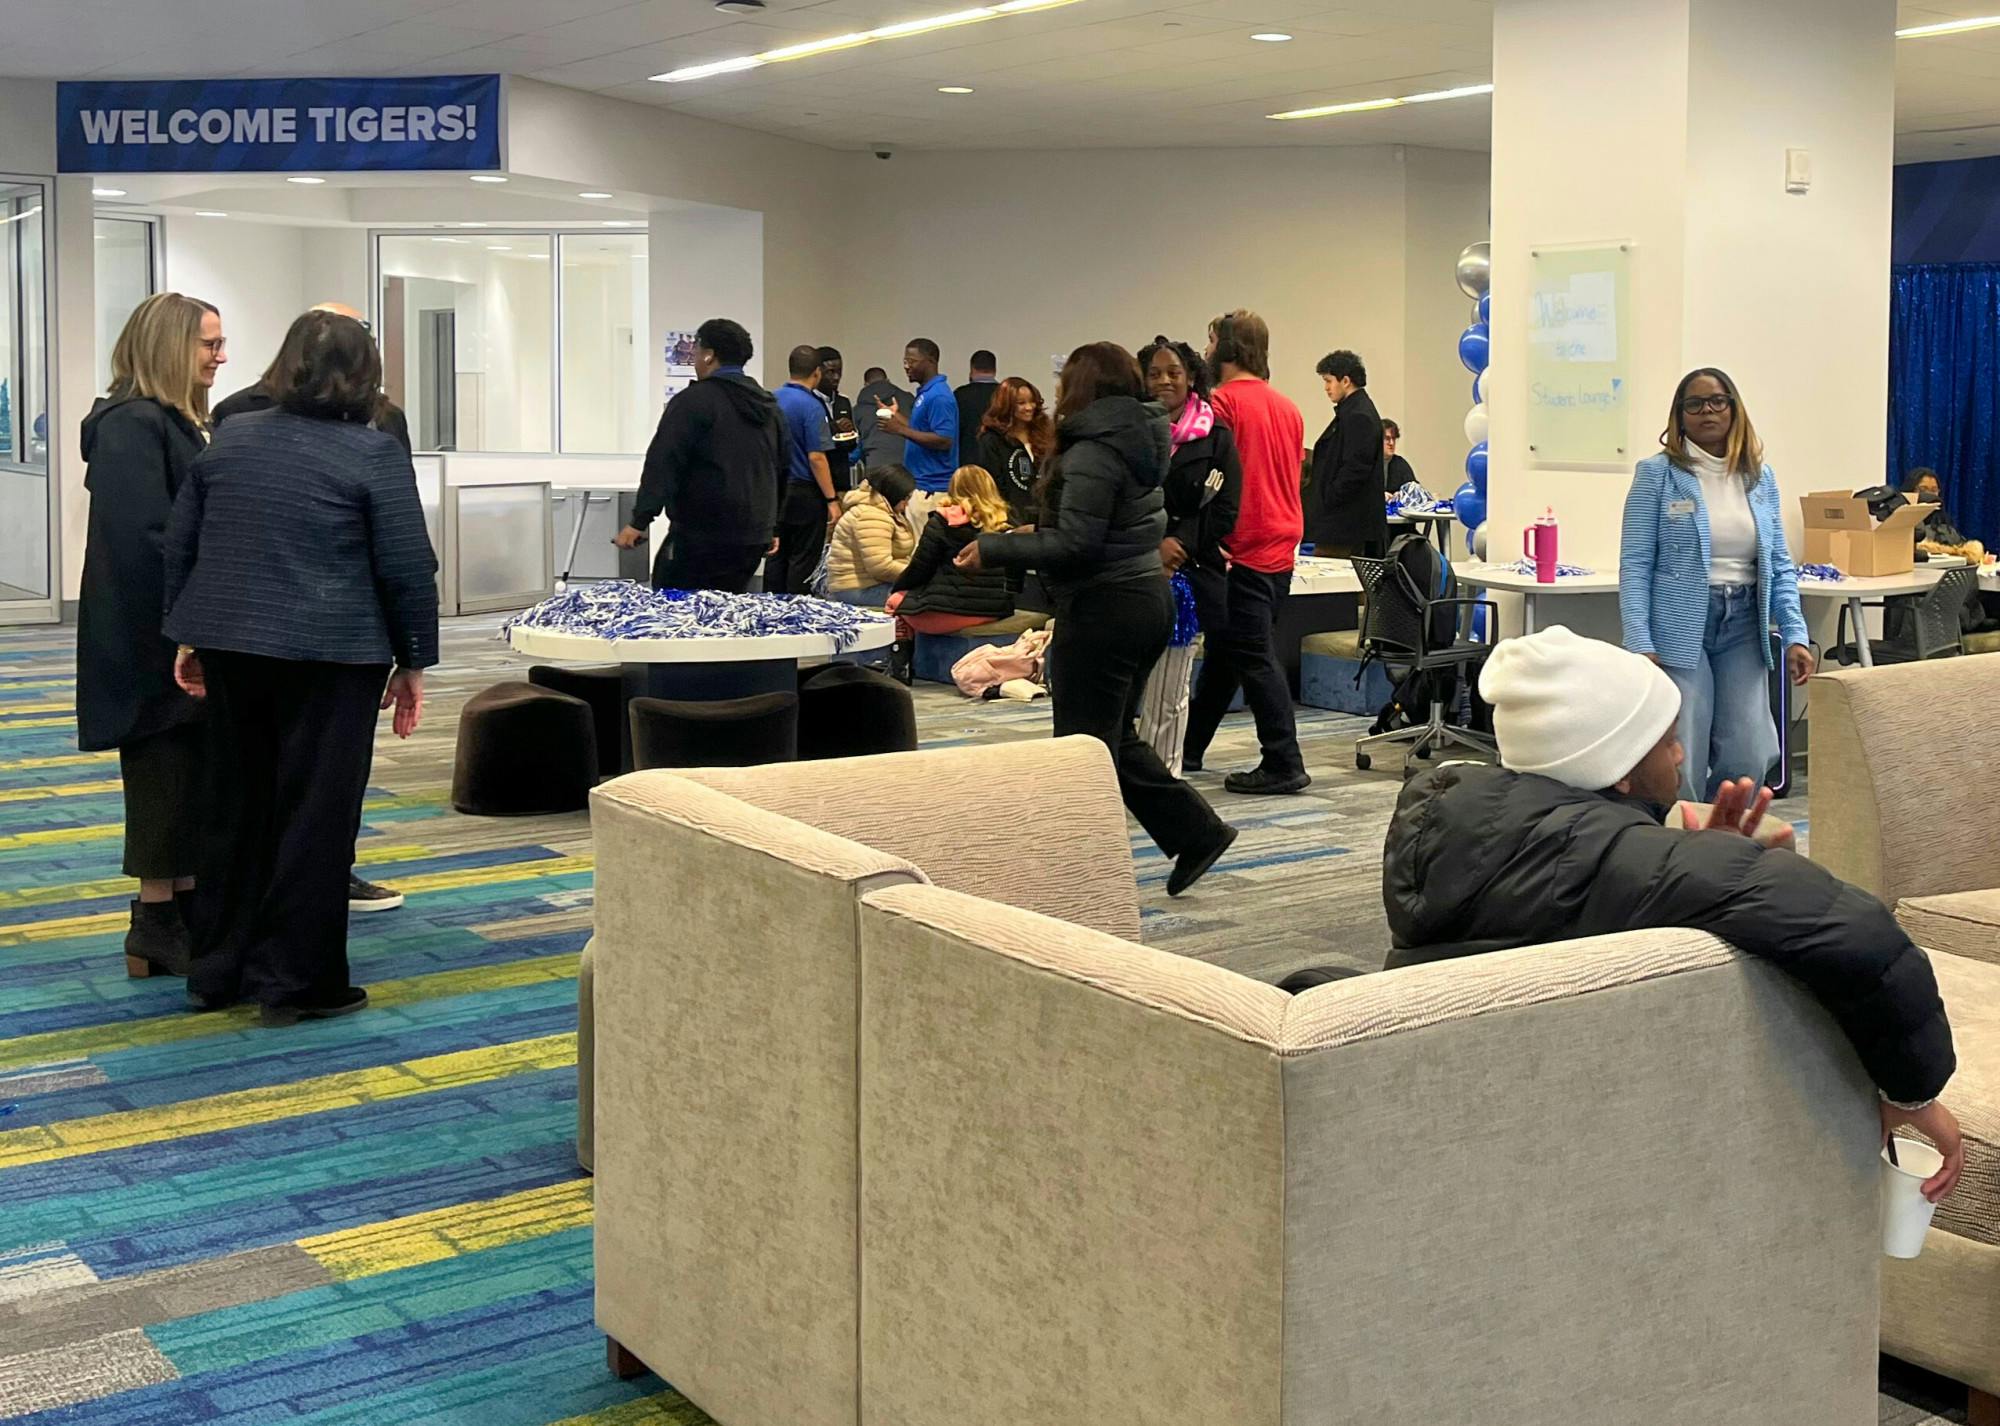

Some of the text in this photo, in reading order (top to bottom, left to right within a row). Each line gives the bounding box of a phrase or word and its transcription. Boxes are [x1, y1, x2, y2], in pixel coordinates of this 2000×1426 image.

[80, 104, 477, 145] WELCOME TIGERS!
[1535, 291, 1599, 328] Welcome
[1531, 381, 1576, 405] Student
